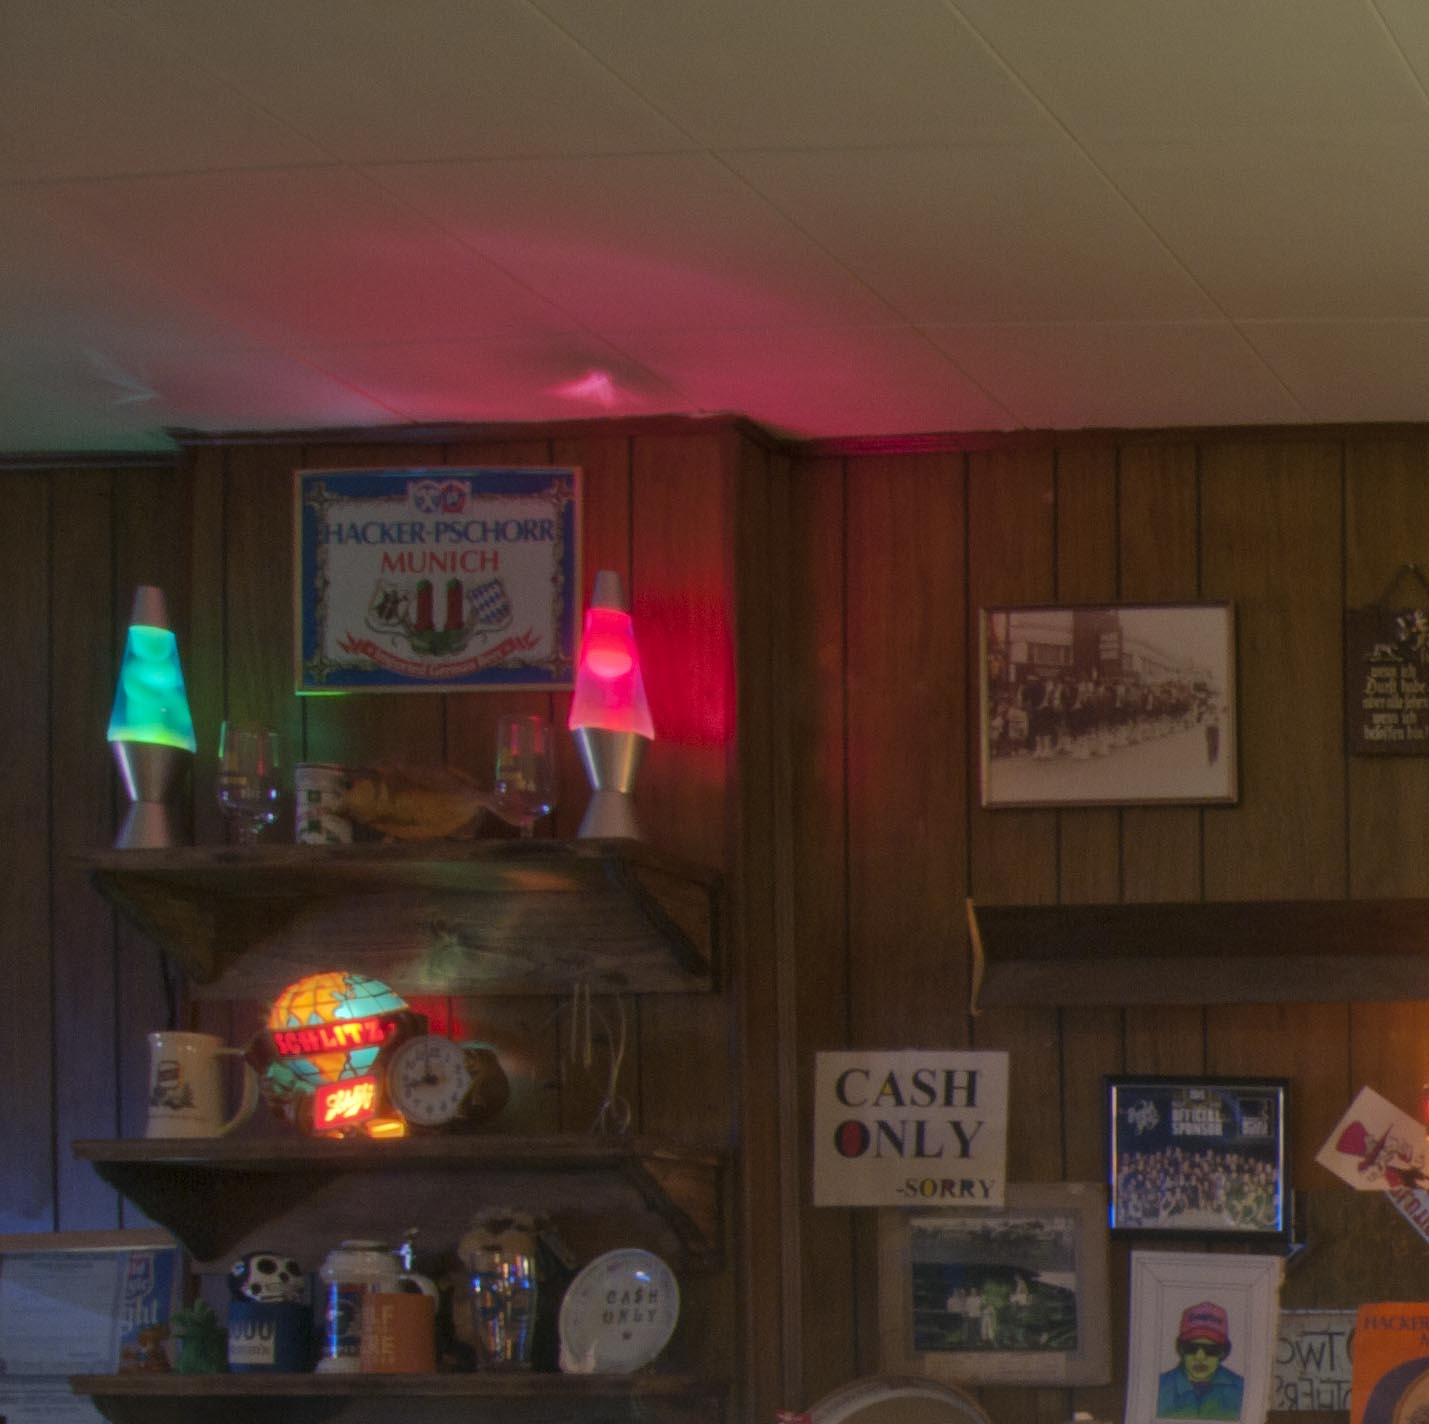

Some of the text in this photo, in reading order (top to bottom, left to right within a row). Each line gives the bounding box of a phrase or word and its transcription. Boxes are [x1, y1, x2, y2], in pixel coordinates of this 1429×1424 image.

[323, 518, 555, 545] HACKER-PSCHORR
[380, 550, 500, 574] MUNICH
[835, 1067, 979, 1108] CASH
[834, 1119, 986, 1159] ONLY
[896, 1177, 995, 1199] -SORRY
[602, 1309, 658, 1325] ONLY
